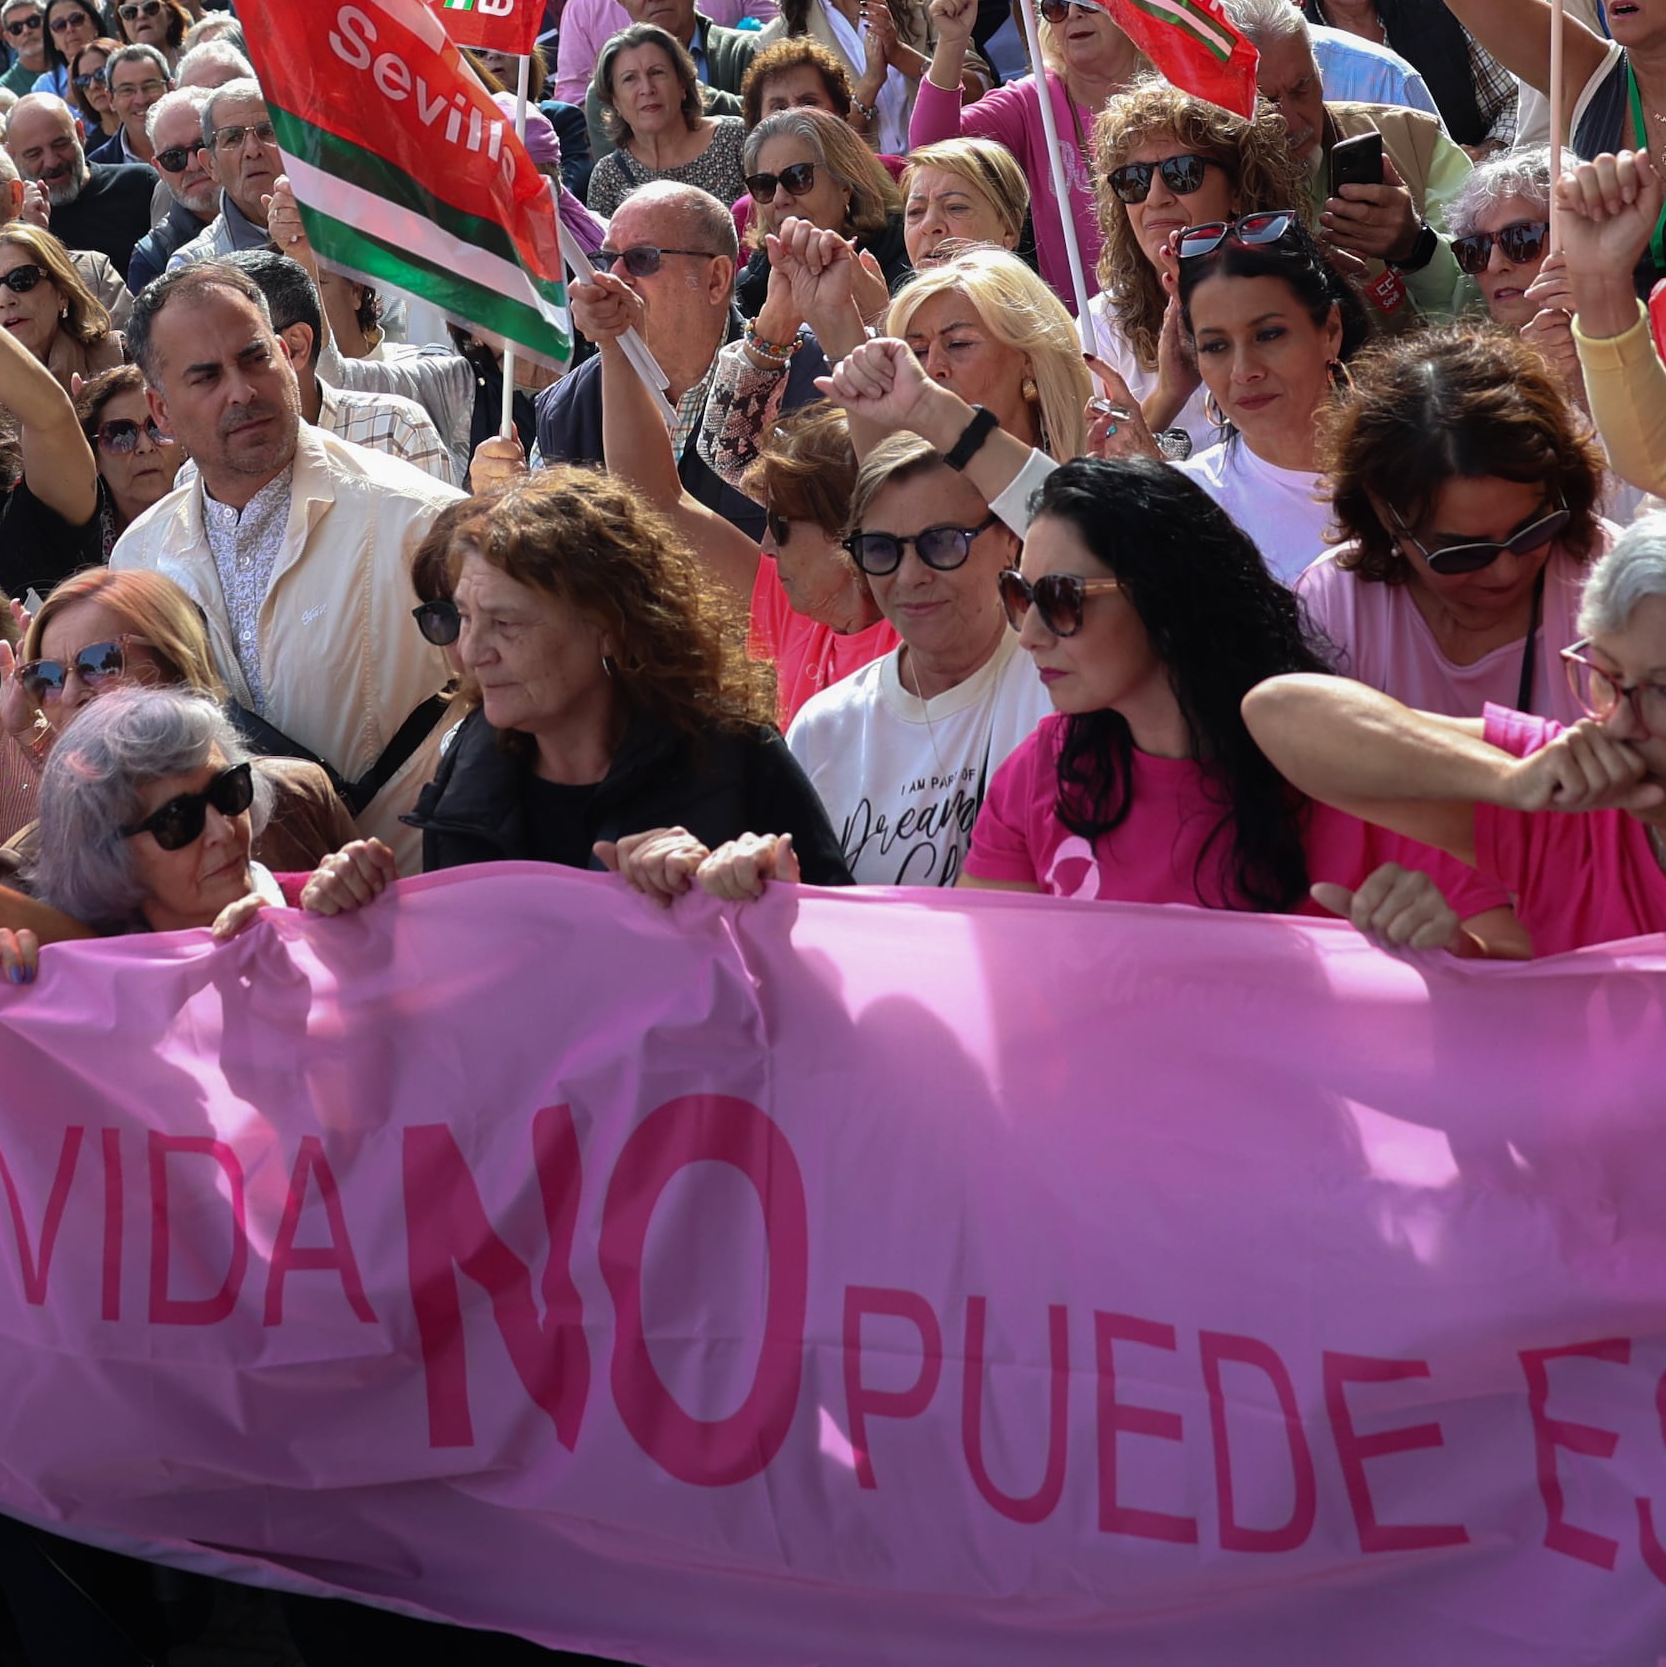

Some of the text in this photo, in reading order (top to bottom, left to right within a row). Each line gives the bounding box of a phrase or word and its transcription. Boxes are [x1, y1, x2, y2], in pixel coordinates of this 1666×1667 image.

[909, 778, 926, 794] AM
[961, 767, 976, 782] OF
[402, 1093, 809, 1488] NO
[844, 1286, 1471, 1556] PUEDE
